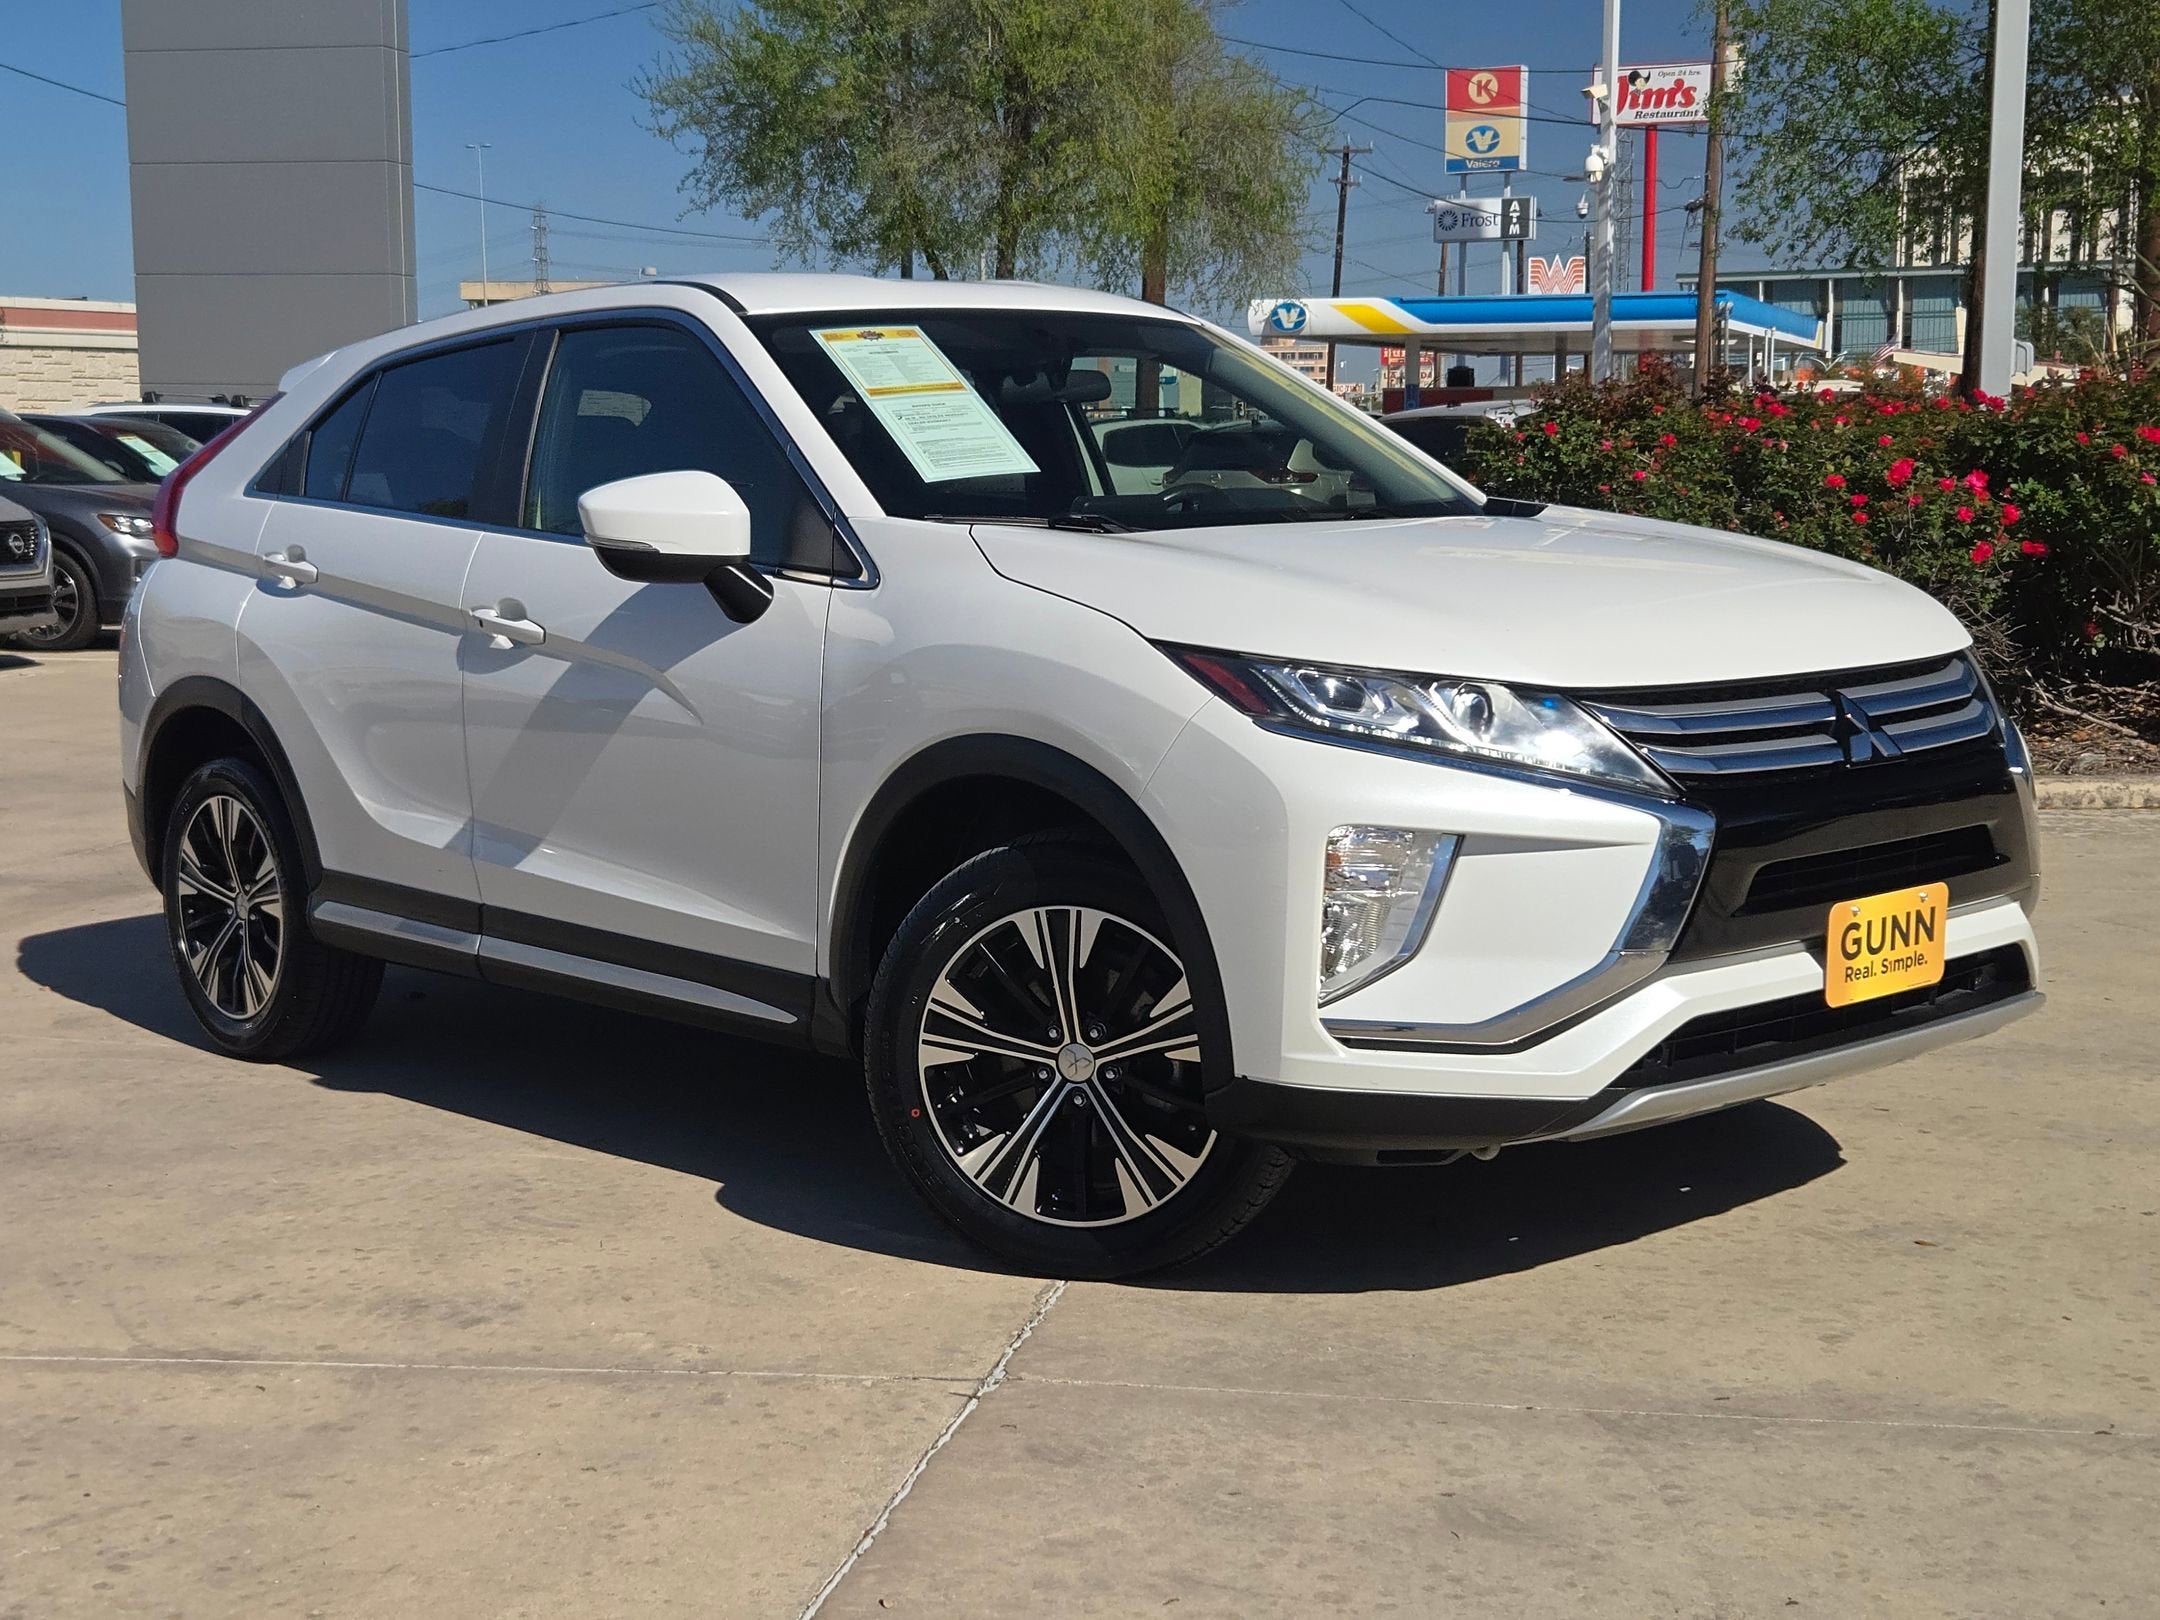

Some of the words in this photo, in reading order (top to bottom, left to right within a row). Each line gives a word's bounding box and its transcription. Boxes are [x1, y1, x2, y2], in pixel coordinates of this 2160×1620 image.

[1658, 70, 1675, 78] Open
[1677, 69, 1687, 77] 24
[1634, 109, 1699, 120] Restaurant
[1465, 159, 1500, 169] Valero
[1461, 212, 1498, 228] Frost
[1508, 200, 1520, 235] ATM
[1840, 906, 1936, 961] GUNN
[1844, 960, 1877, 983] Real.
